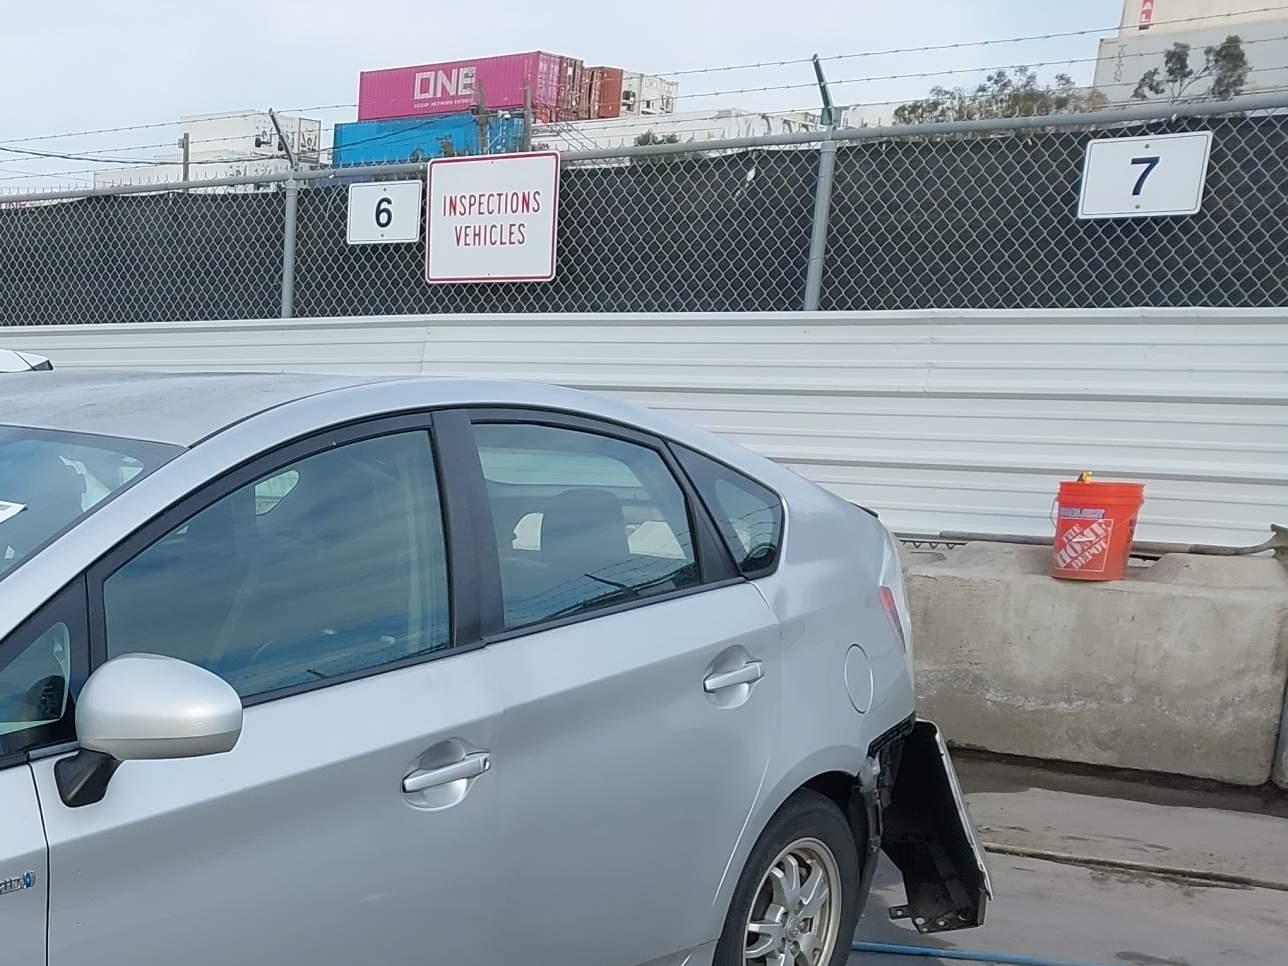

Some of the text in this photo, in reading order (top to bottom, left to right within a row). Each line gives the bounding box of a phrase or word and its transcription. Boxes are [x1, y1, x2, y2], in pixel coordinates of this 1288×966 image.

[414, 66, 476, 99] ONE
[1131, 156, 1160, 196] 7
[375, 197, 393, 228] 6
[443, 191, 541, 217] INSPECTIONS
[454, 223, 526, 247] VEHICLES
[1062, 523, 1084, 544] THE
[1071, 539, 1108, 569] DEPOT
